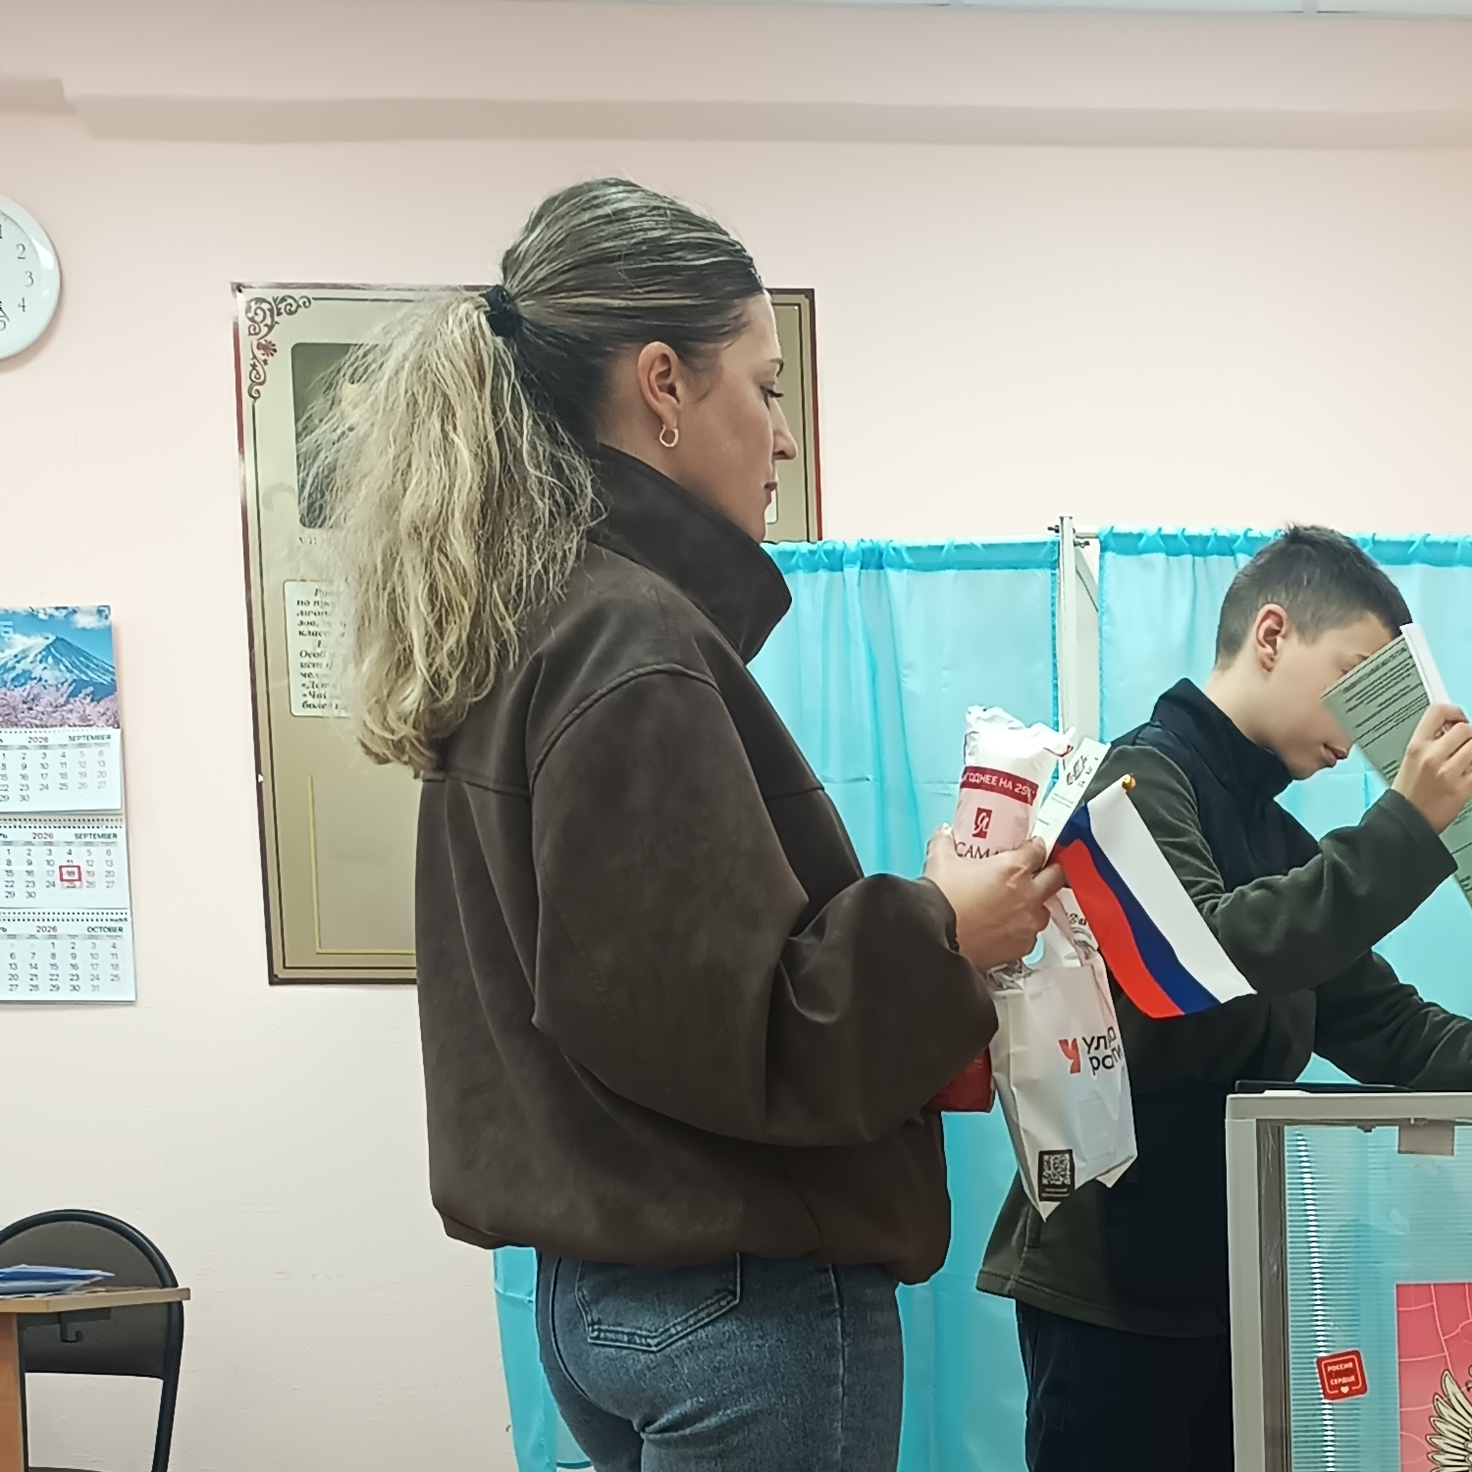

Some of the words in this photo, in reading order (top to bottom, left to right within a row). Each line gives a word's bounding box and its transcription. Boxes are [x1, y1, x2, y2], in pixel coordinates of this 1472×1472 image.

[16, 243, 26, 260] 2
[24, 270, 35, 287] 3
[17, 297, 26, 313] 4
[998, 777, 1013, 790] НА
[956, 841, 999, 859] САМ
